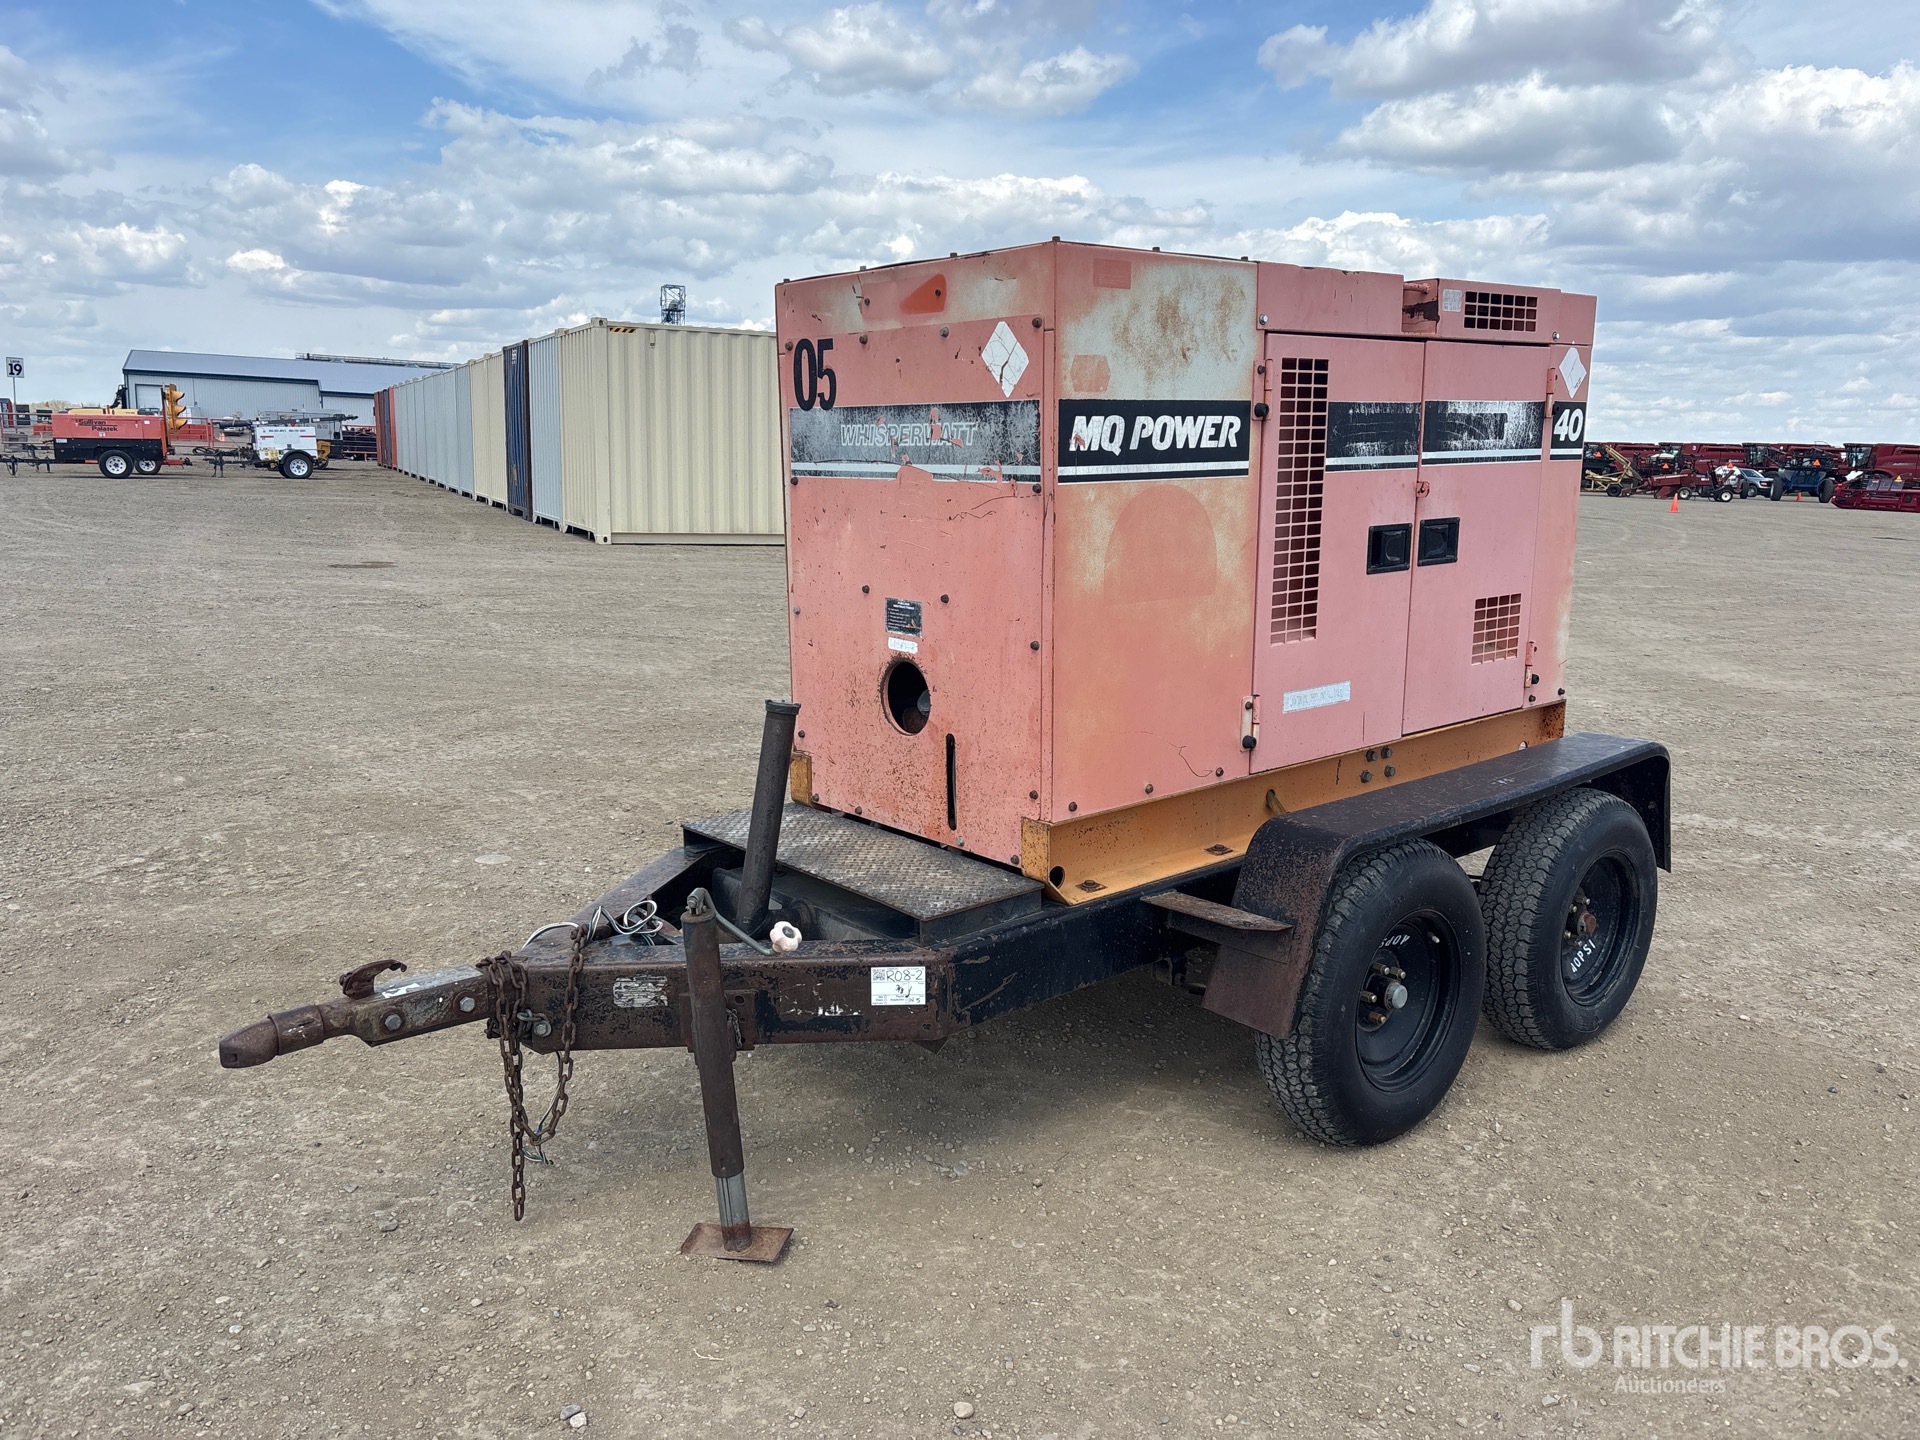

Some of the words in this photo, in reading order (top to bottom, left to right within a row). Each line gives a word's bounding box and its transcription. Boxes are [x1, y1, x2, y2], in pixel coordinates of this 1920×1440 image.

[8, 363, 23, 376] 19
[793, 338, 837, 411] 05
[840, 422, 979, 447] WHISPERWATT
[1069, 415, 1126, 457] MQ
[1129, 415, 1242, 451] POWER
[1553, 408, 1584, 442] 40
[1570, 939, 1596, 973] 40PSI
